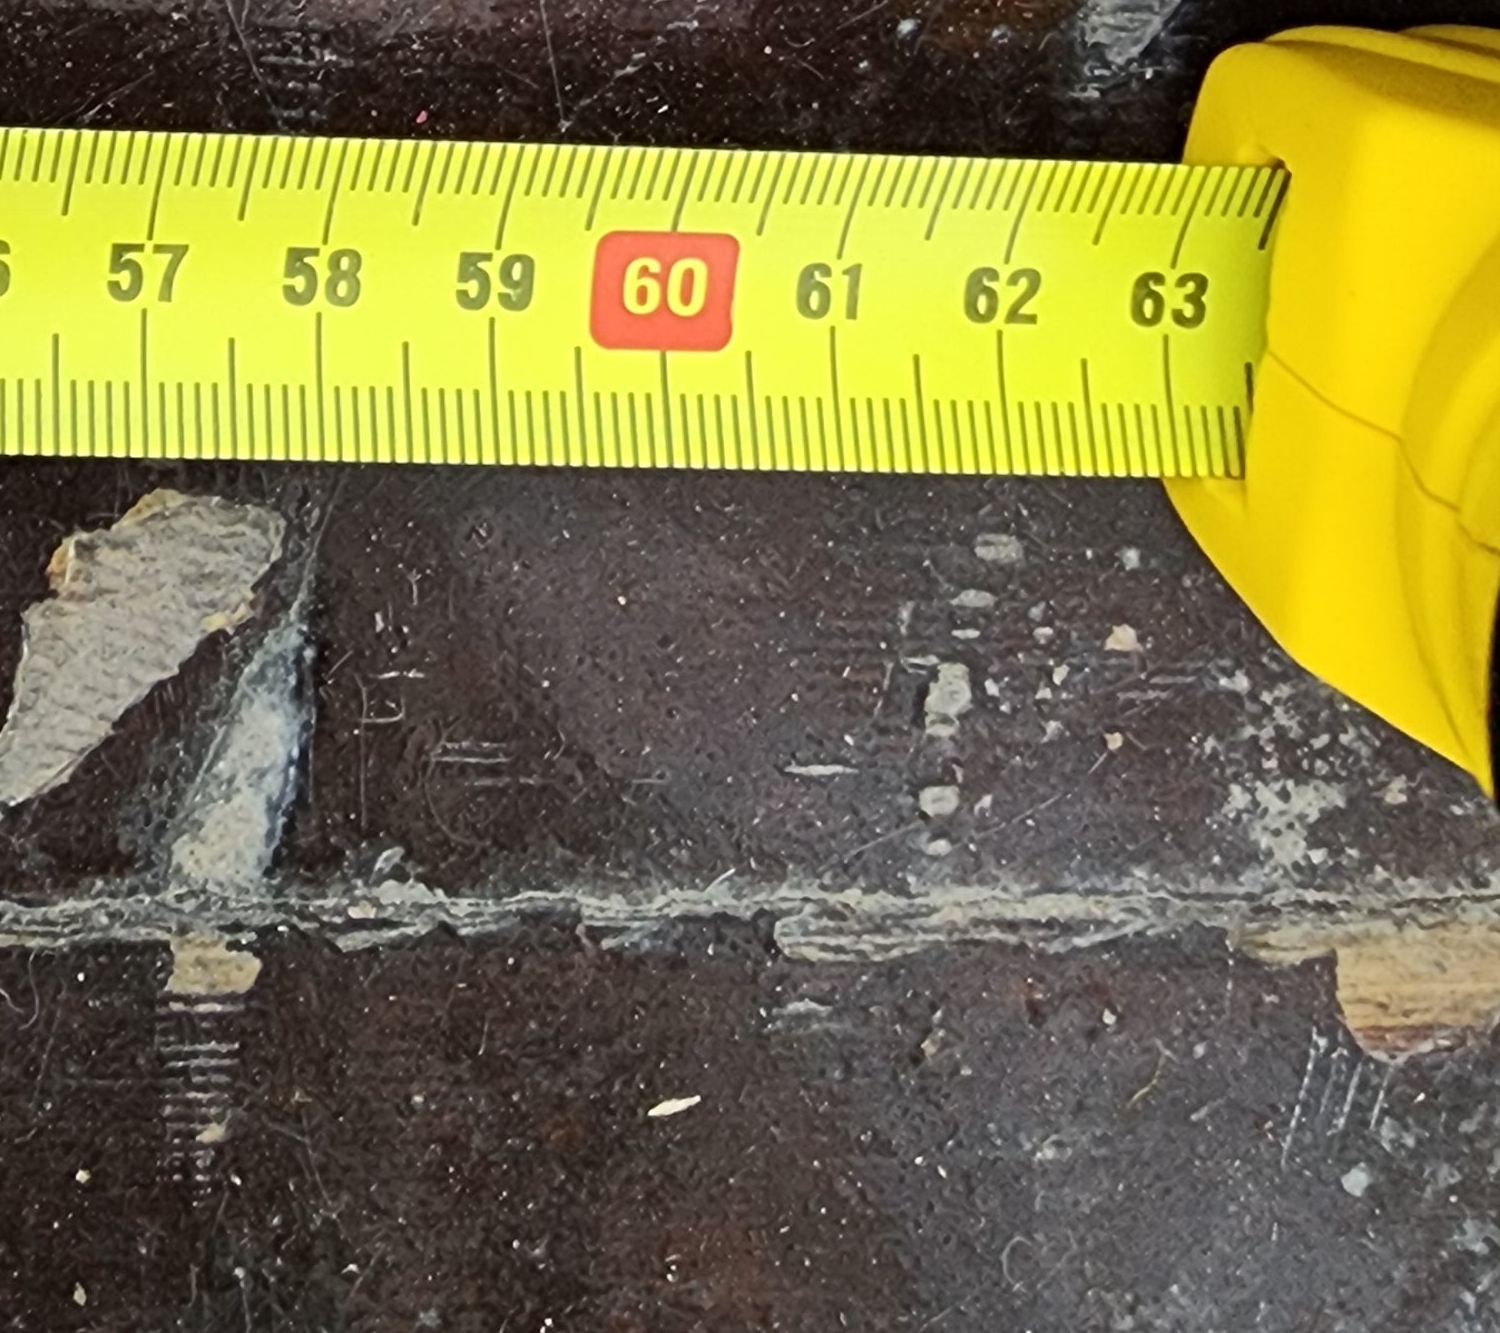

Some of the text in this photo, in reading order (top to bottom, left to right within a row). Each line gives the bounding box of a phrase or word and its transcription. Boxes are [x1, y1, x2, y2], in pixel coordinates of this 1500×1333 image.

[106, 242, 190, 304] 57
[282, 246, 362, 308] 58
[455, 251, 536, 313] 59
[622, 256, 709, 318] 60
[796, 263, 863, 321] 61
[963, 267, 1043, 326] 62
[1130, 271, 1209, 330] 63
